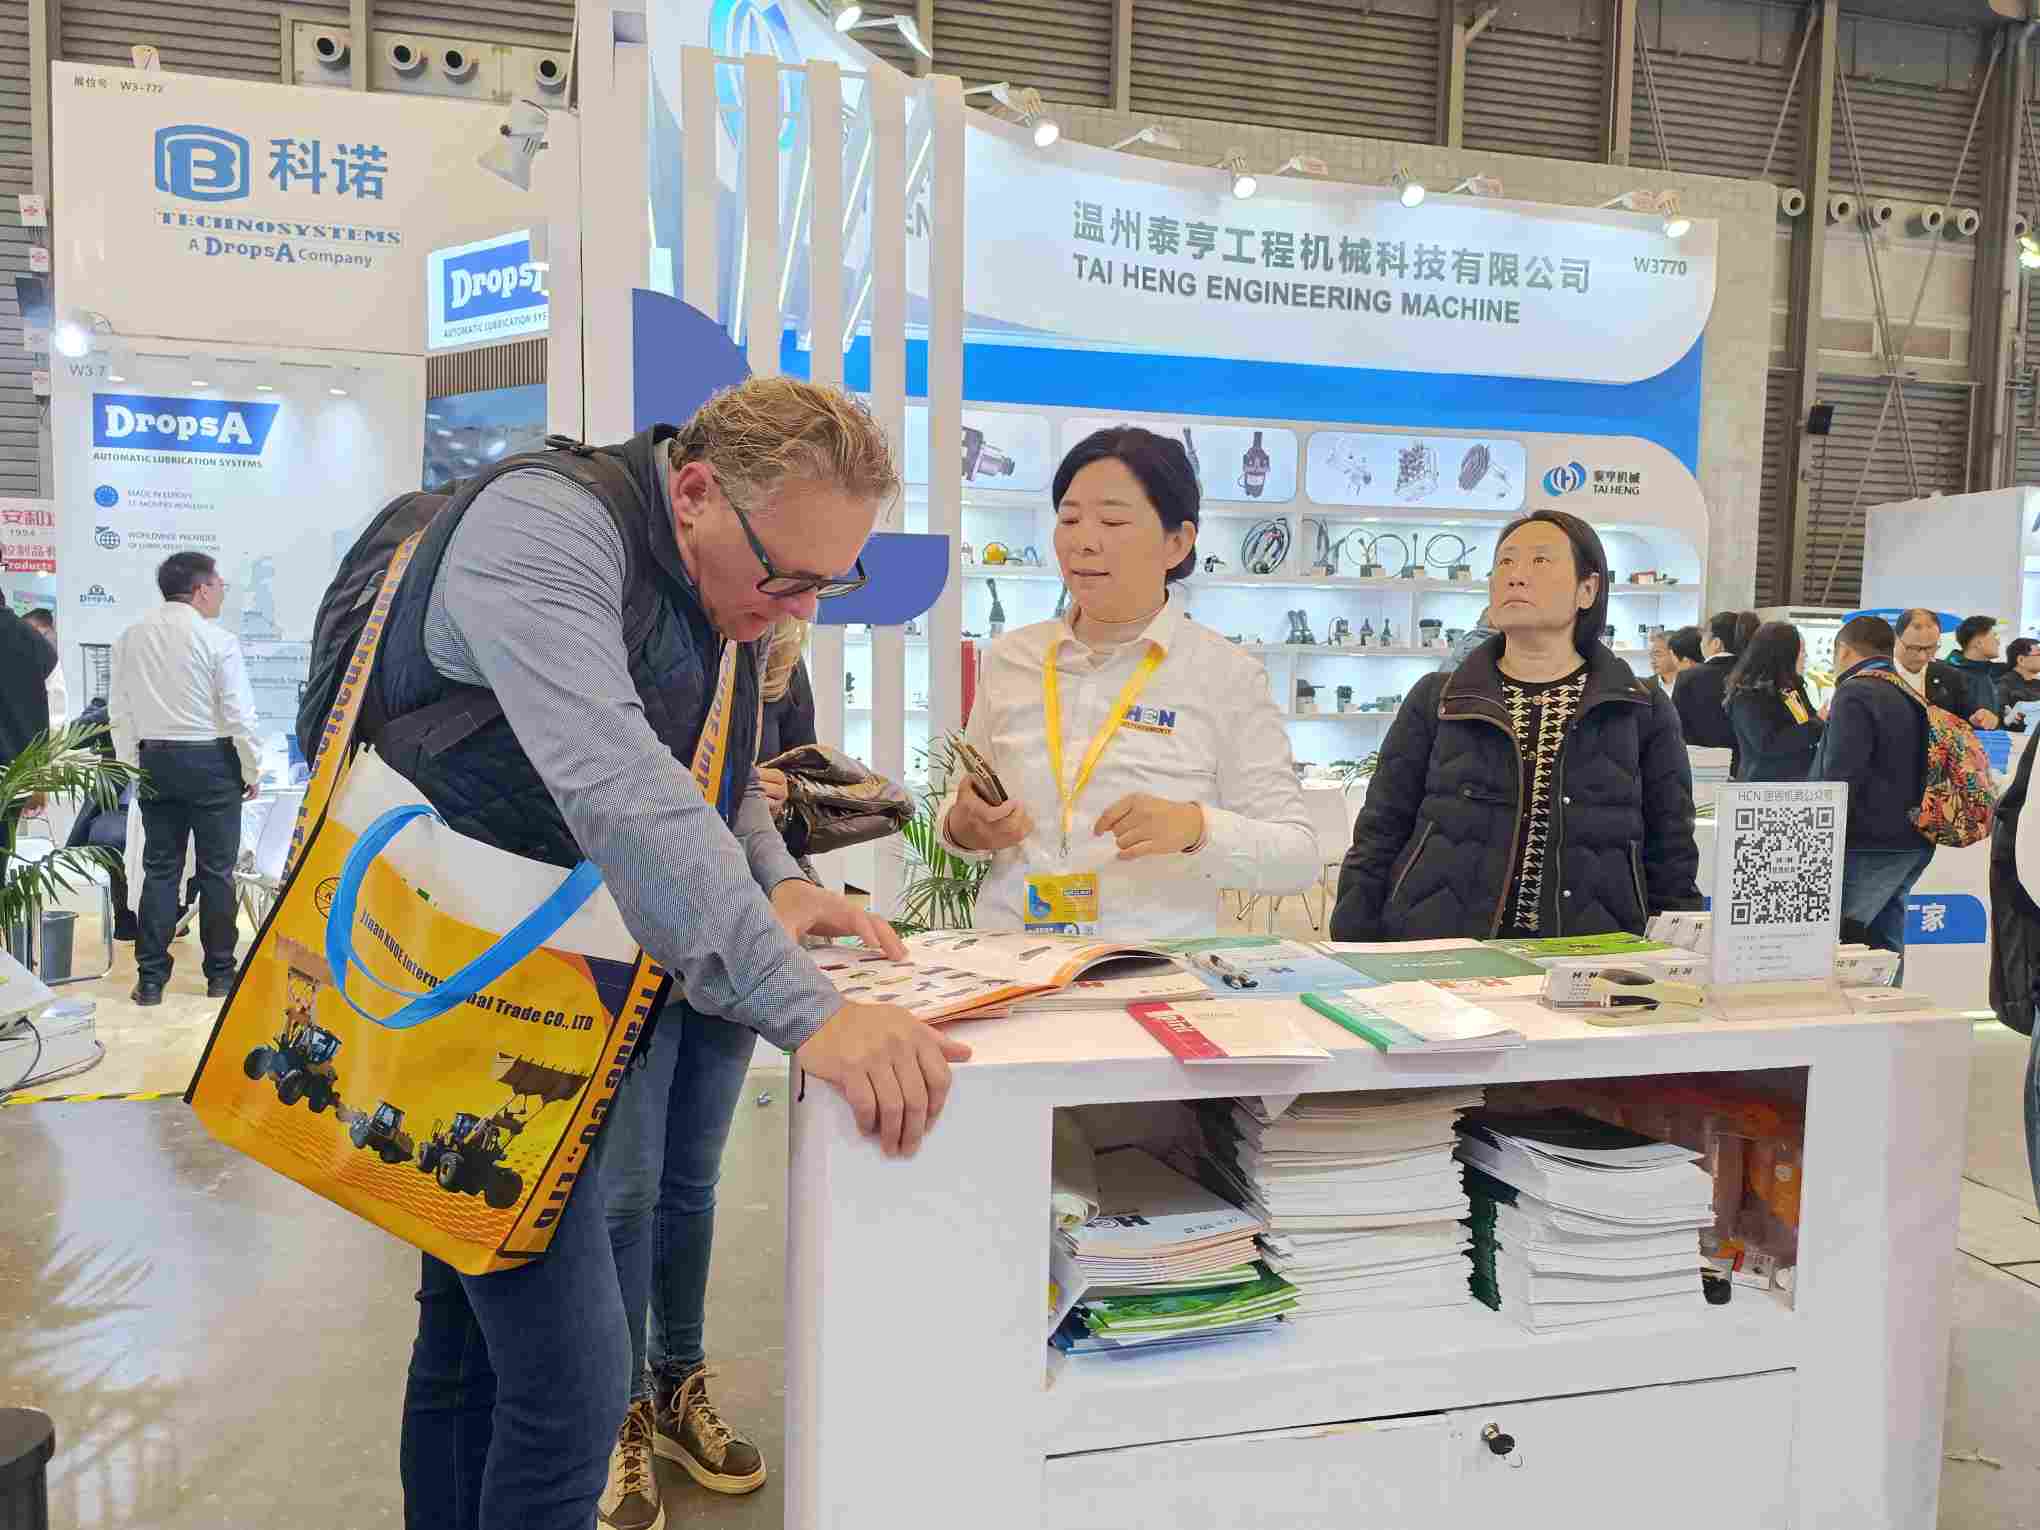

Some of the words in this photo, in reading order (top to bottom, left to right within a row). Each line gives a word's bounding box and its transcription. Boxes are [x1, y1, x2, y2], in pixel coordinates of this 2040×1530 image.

[268, 138, 389, 200] 科诺
[157, 210, 402, 244] TECHNOSYSTEMS
[189, 238, 199, 250] A
[205, 236, 296, 263] DropsA
[297, 248, 373, 269] Company
[1073, 200, 1591, 294] 温州泰亨工程机械科技有限公司
[1633, 254, 1689, 275] W3770
[1073, 252, 1113, 285] TAI
[1122, 262, 1197, 298] HENG
[1206, 274, 1393, 313] ENGINEERING
[1400, 292, 1521, 325] MACHINE
[105, 404, 253, 445] DropsA
[93, 451, 151, 464] AUTOMATIC
[152, 454, 217, 467] LUBRICATION
[219, 458, 264, 469] SYSTEMS
[1610, 484, 1641, 496] HENG
[495, 998, 546, 1024] Trade
[571, 1014, 594, 1032] LTD
